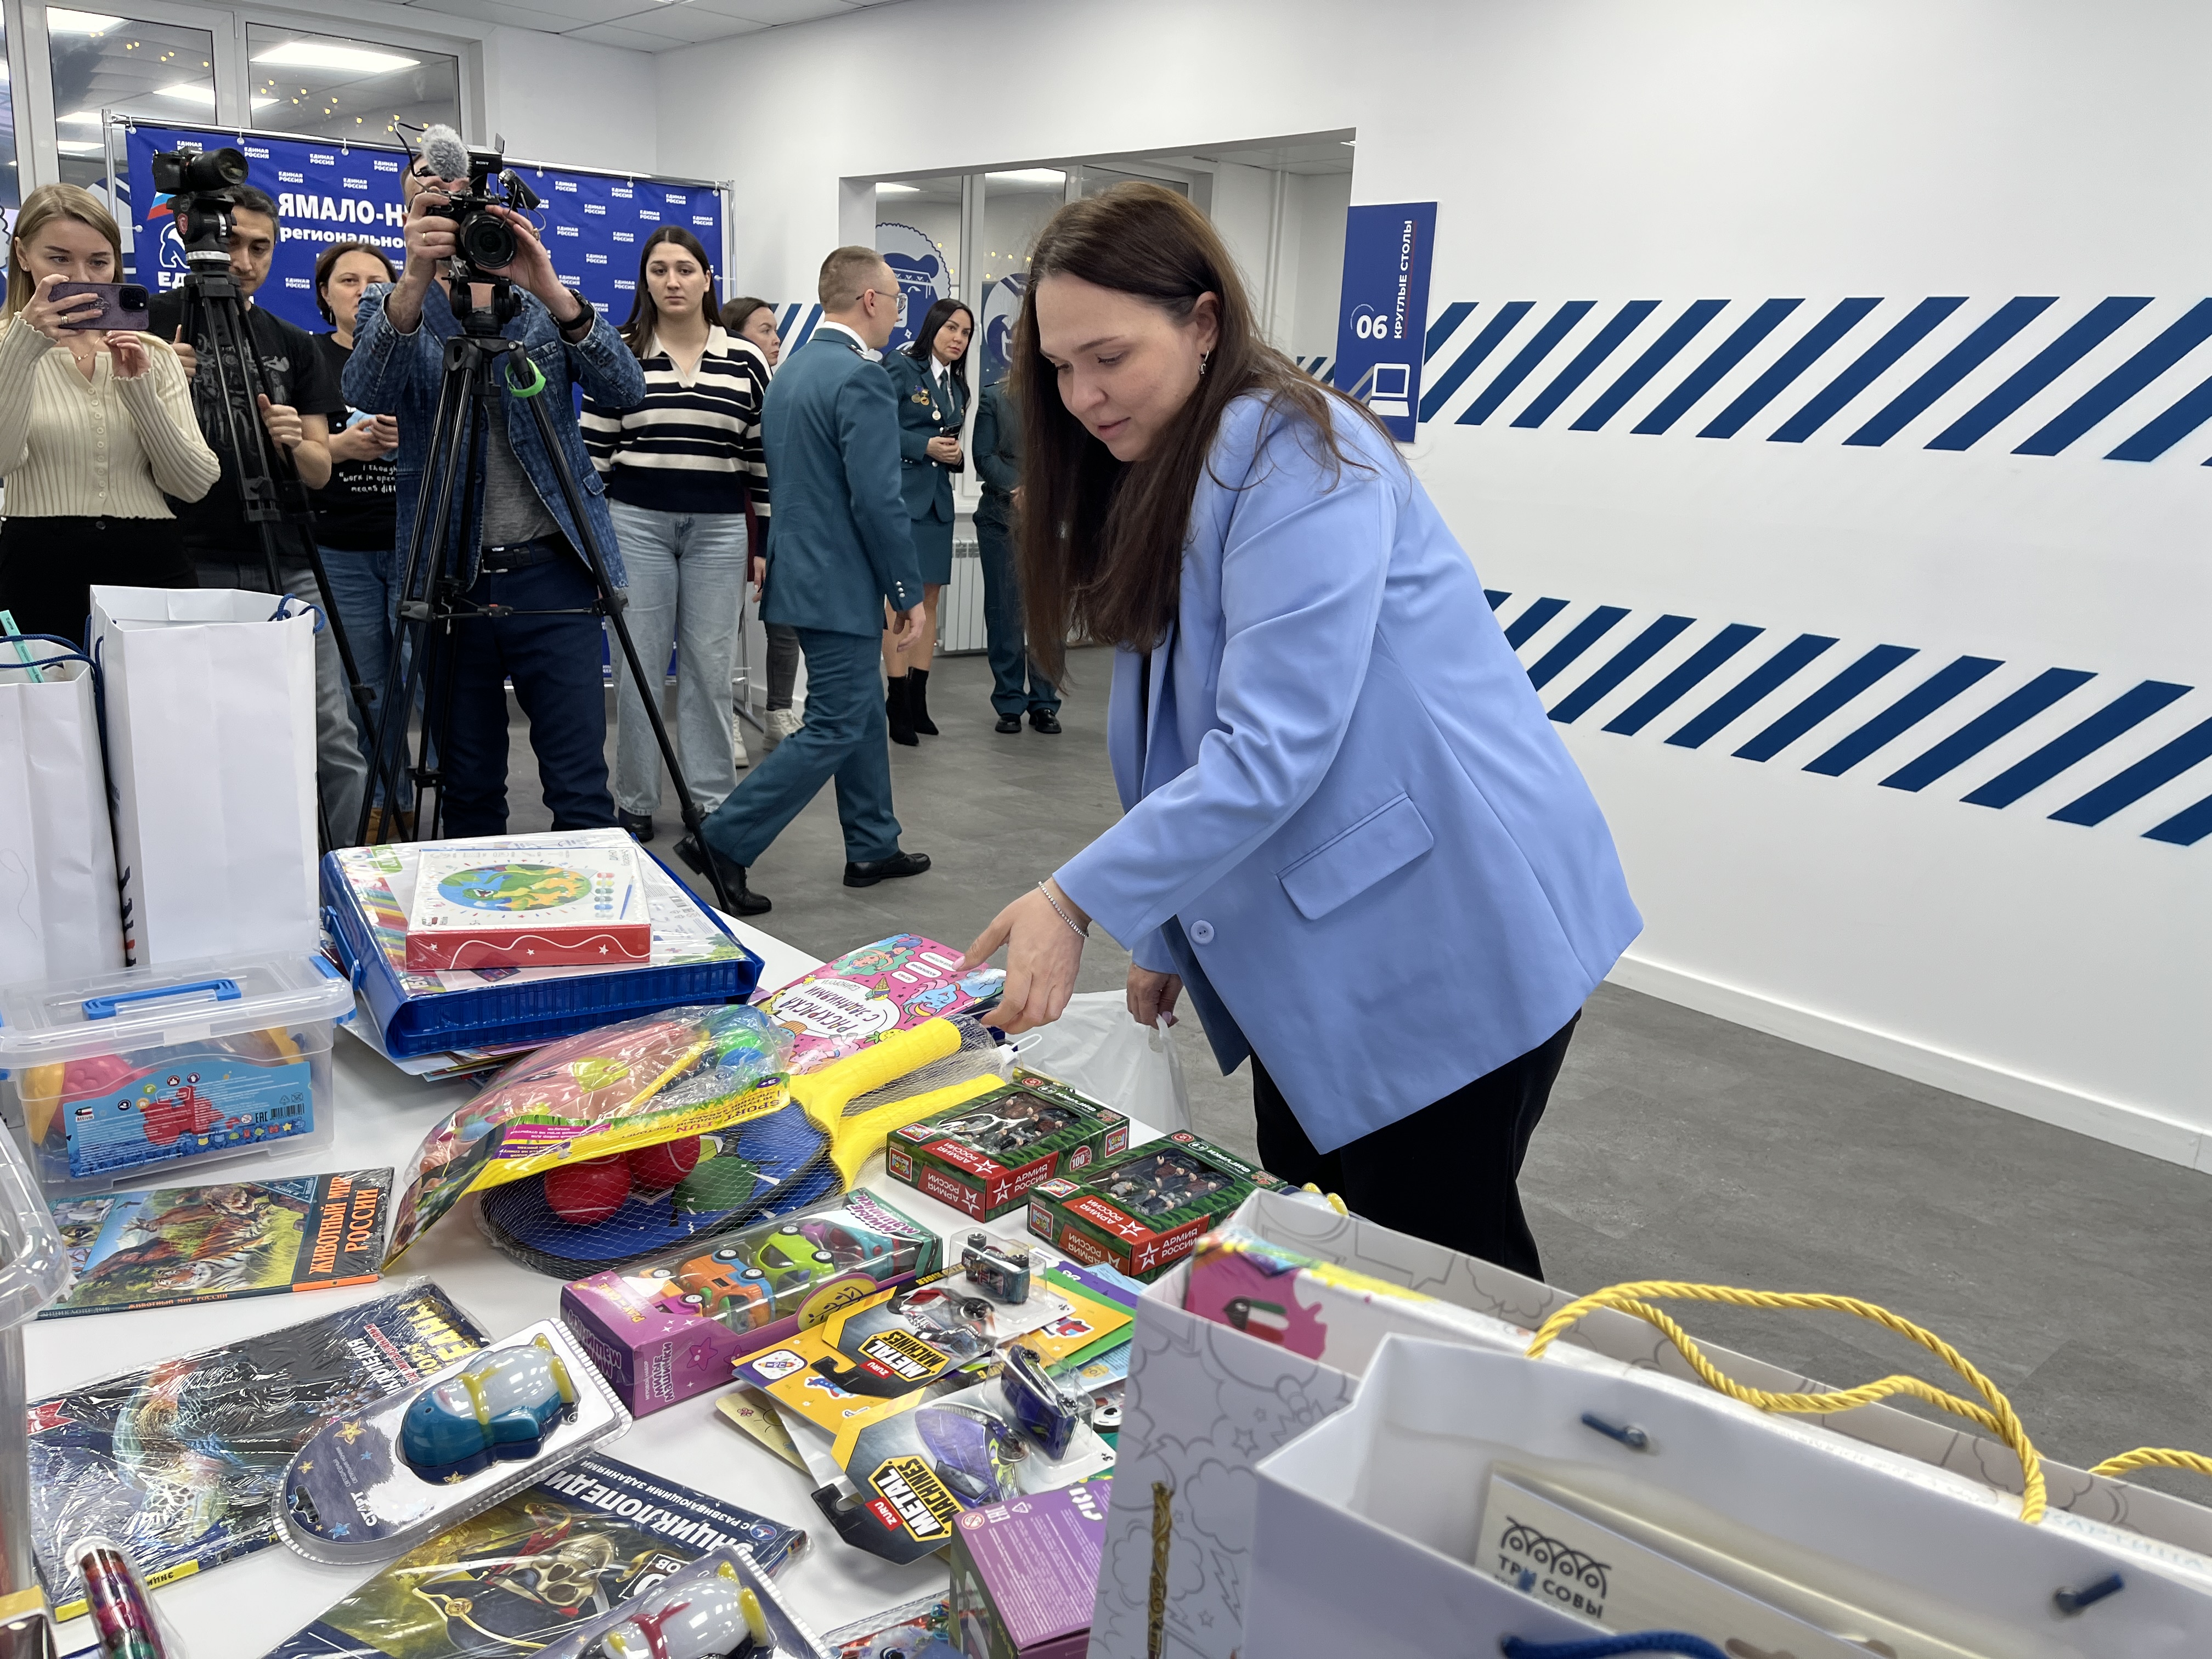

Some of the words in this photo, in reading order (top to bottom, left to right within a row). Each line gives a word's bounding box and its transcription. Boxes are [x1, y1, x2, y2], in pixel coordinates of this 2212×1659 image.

[1394, 274, 1407, 339] КРУГЛЫЕ
[1401, 220, 1413, 271] СТОЛЫ
[1356, 314, 1388, 339] 06
[804, 984, 872, 1020] ЗАДАНИЯМИ
[778, 994, 859, 1037] РАСКРАСКА
[255, 1111, 268, 1122] EAC
[724, 1099, 780, 1122] SPORT
[675, 1121, 713, 1133] FUN
[936, 1145, 972, 1165] АРМИЯ
[943, 1141, 979, 1161] РОССИИ
[1207, 1148, 1251, 1173] ФИГУРКИ
[927, 1172, 960, 1194] РОССИИ
[1014, 1172, 1047, 1193] РОССИИ
[1015, 1164, 1047, 1183] АРМИЯ
[927, 1182, 959, 1203] АРМИЯ
[345, 1188, 379, 1252] РОССИИ
[846, 1203, 896, 1233] МИЛЫЕ
[1079, 1203, 1116, 1226] АРМИЯ
[1087, 1199, 1124, 1222] РОССИИ
[309, 1202, 347, 1274] ЖИВОТНЫЙ
[328, 1176, 353, 1199] МИР
[1068, 1232, 1102, 1257] РОССИИ
[1161, 1237, 1197, 1258] РОССИИ
[1163, 1228, 1197, 1249] АРМИЯ
[867, 1340, 927, 1378] METAL
[882, 1331, 945, 1367] MACHINES
[652, 1355, 663, 1398] МИЛЫЕ
[867, 1362, 889, 1375] ZURU
[580, 1458, 647, 1489] ЗАДАНИЯМИ
[877, 1469, 940, 1536] METAL
[898, 1458, 960, 1523] MACHINES
[647, 1484, 741, 1526] РАЗВИВАЮЩИМИ
[874, 1502, 897, 1525] ZURU
[738, 1520, 750, 1533] С
[1542, 1579, 1604, 1619] СОВЫ
